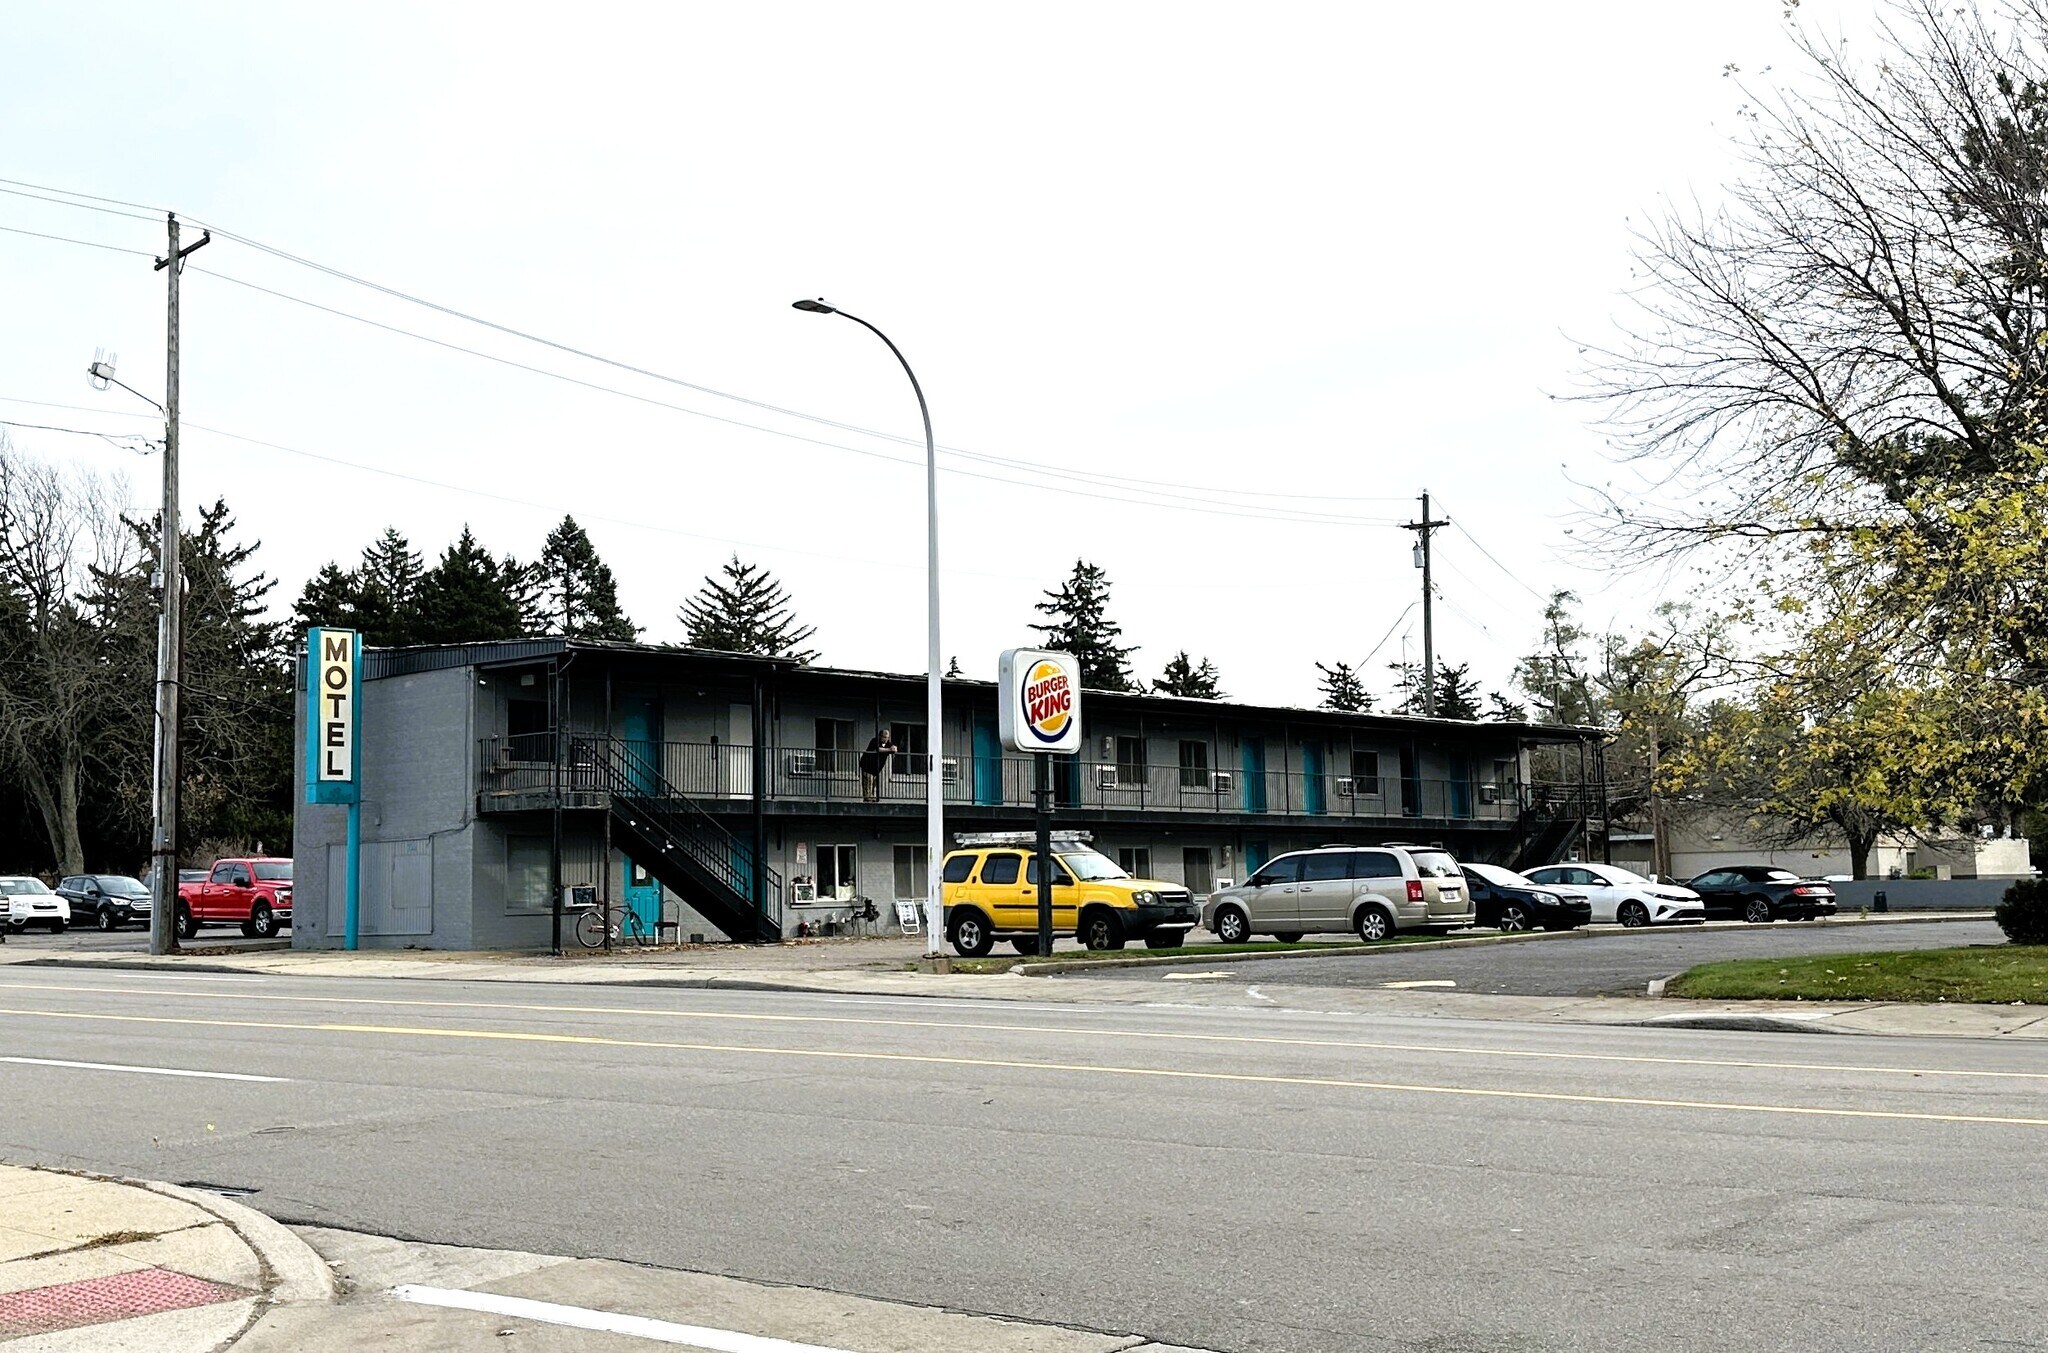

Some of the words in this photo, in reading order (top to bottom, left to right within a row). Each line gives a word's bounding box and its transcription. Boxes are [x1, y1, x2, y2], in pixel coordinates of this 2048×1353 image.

[325, 637, 348, 776] MOTEL
[1028, 675, 1069, 703] BURGER
[1030, 689, 1071, 725] KING
